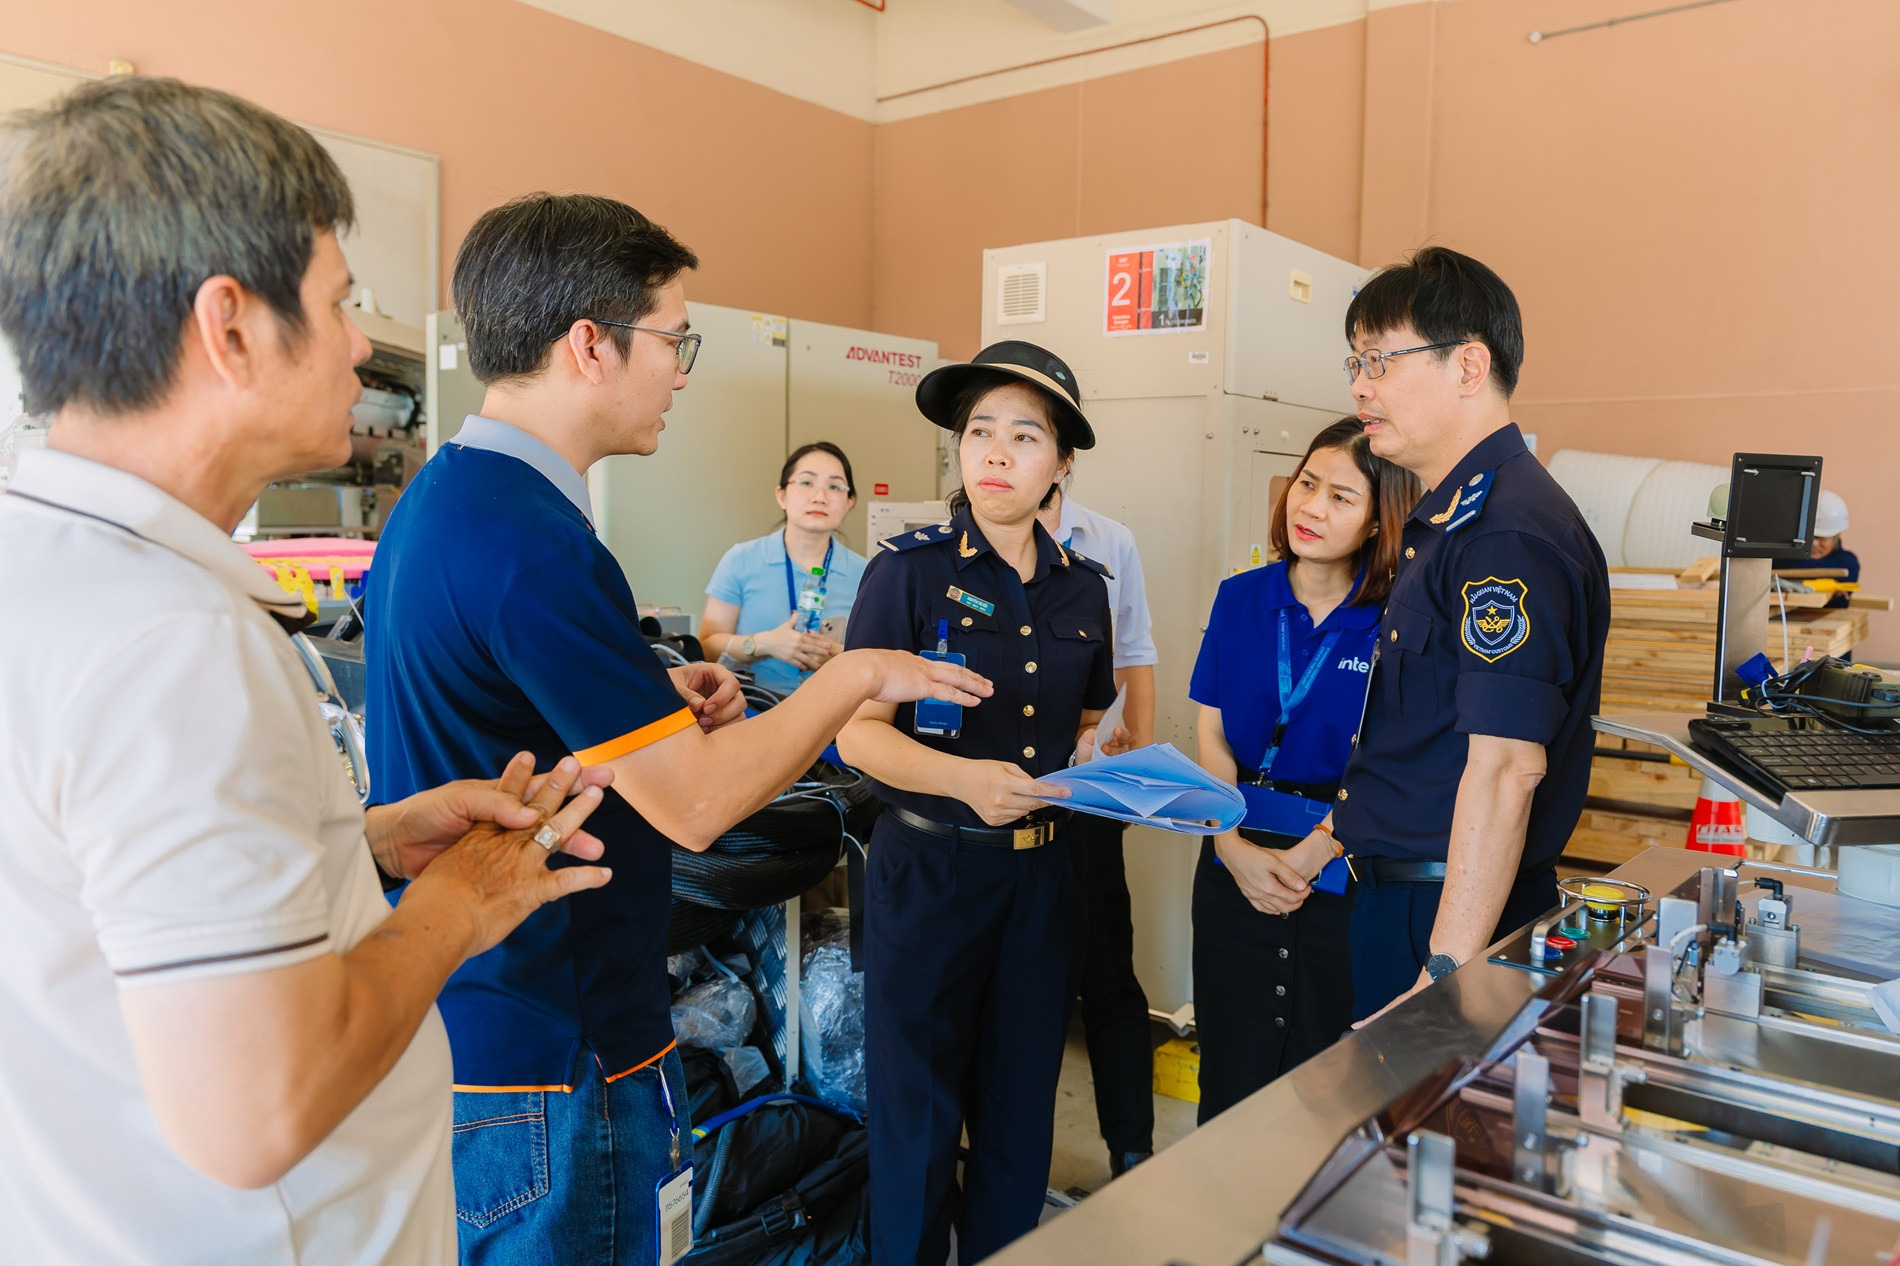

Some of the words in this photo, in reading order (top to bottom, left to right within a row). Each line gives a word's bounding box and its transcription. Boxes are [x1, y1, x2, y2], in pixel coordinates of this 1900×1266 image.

[1111, 272, 1131, 306] 2
[846, 346, 922, 368] ADVANTEST
[1476, 587, 1492, 596] QUAN
[1492, 585, 1505, 594] VIỆT
[1504, 589, 1518, 603] NAM
[1491, 643, 1514, 655] CUSTOMS
[1338, 656, 1369, 673] inte
